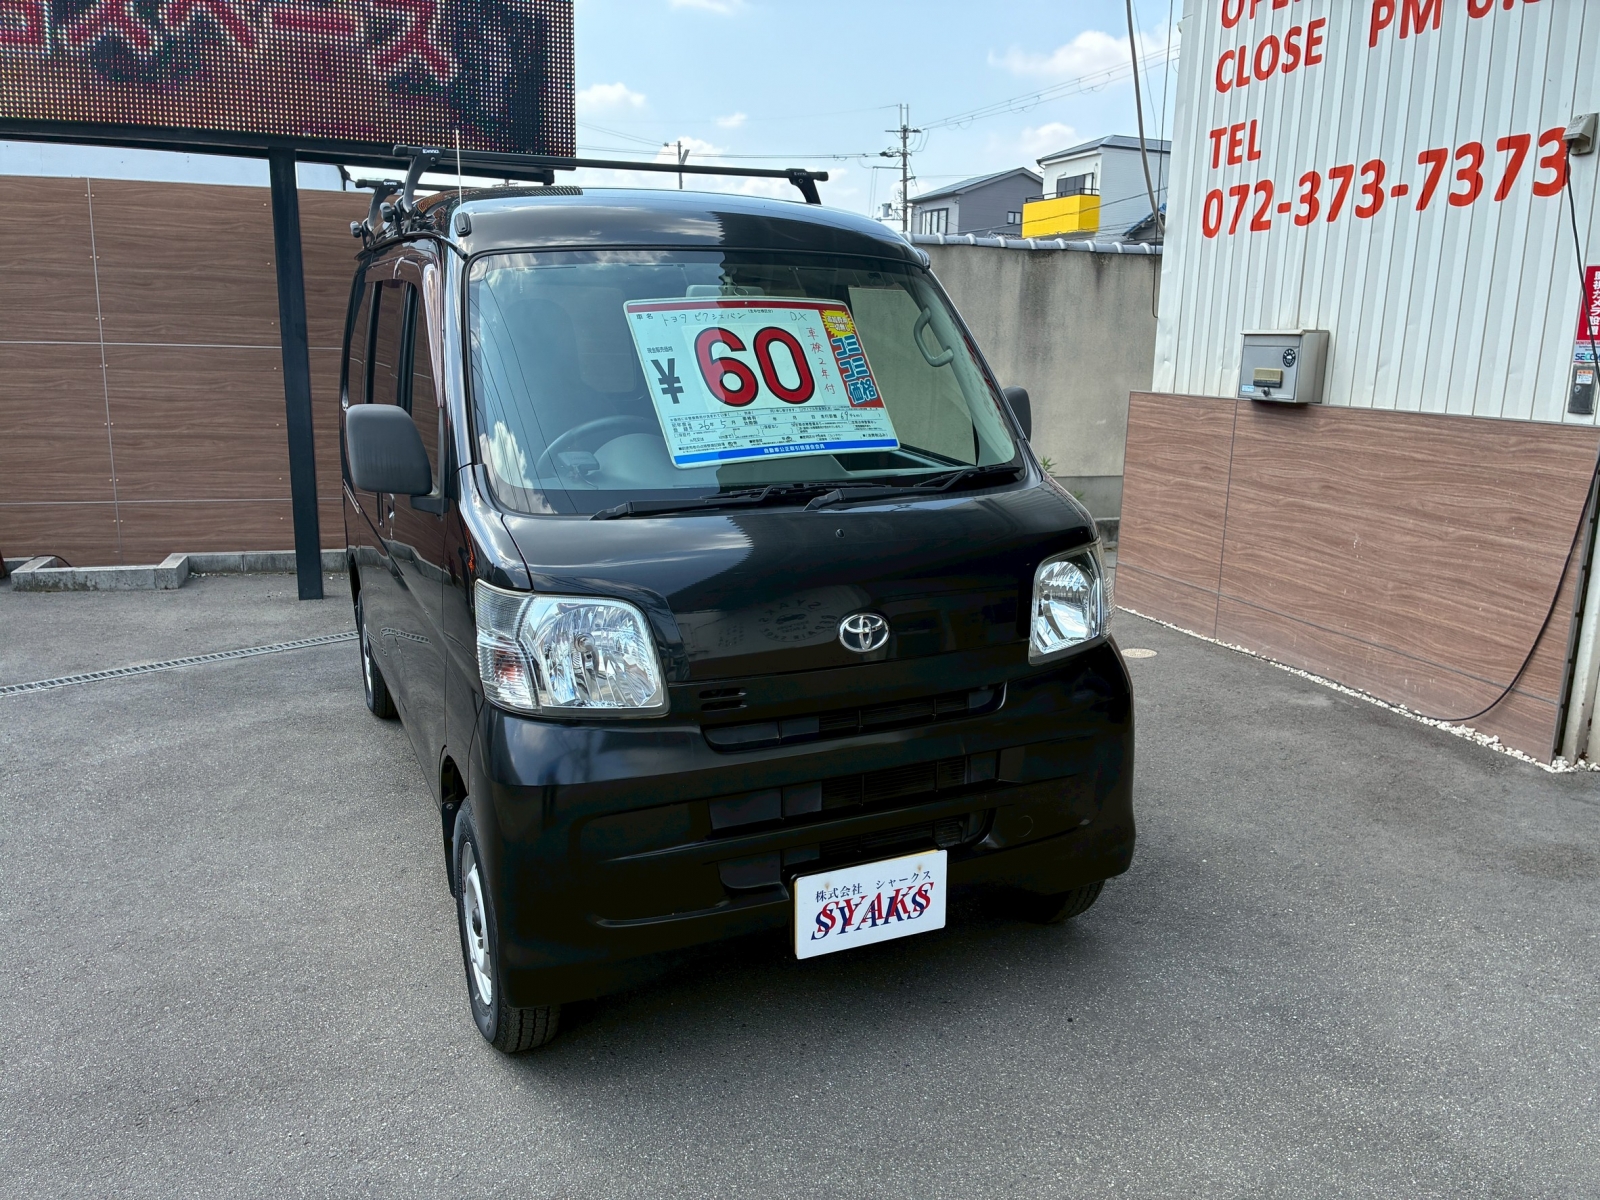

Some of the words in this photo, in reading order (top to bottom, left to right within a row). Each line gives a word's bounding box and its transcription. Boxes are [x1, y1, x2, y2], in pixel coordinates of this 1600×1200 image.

[1215, 17, 1327, 94] CLOSE
[1369, 0, 1444, 48] PM
[1210, 119, 1262, 169] TEL
[1202, 126, 1571, 239] 072-373-7373
[660, 313, 690, 326] トヨタ
[788, 311, 808, 321] DX
[694, 327, 815, 406] 60
[1575, 352, 1600, 361] SECO
[847, 378, 878, 405] 価格
[815, 883, 863, 903] 株式会社
[876, 870, 931, 890] シャークス
[811, 881, 934, 941] SYAKS
